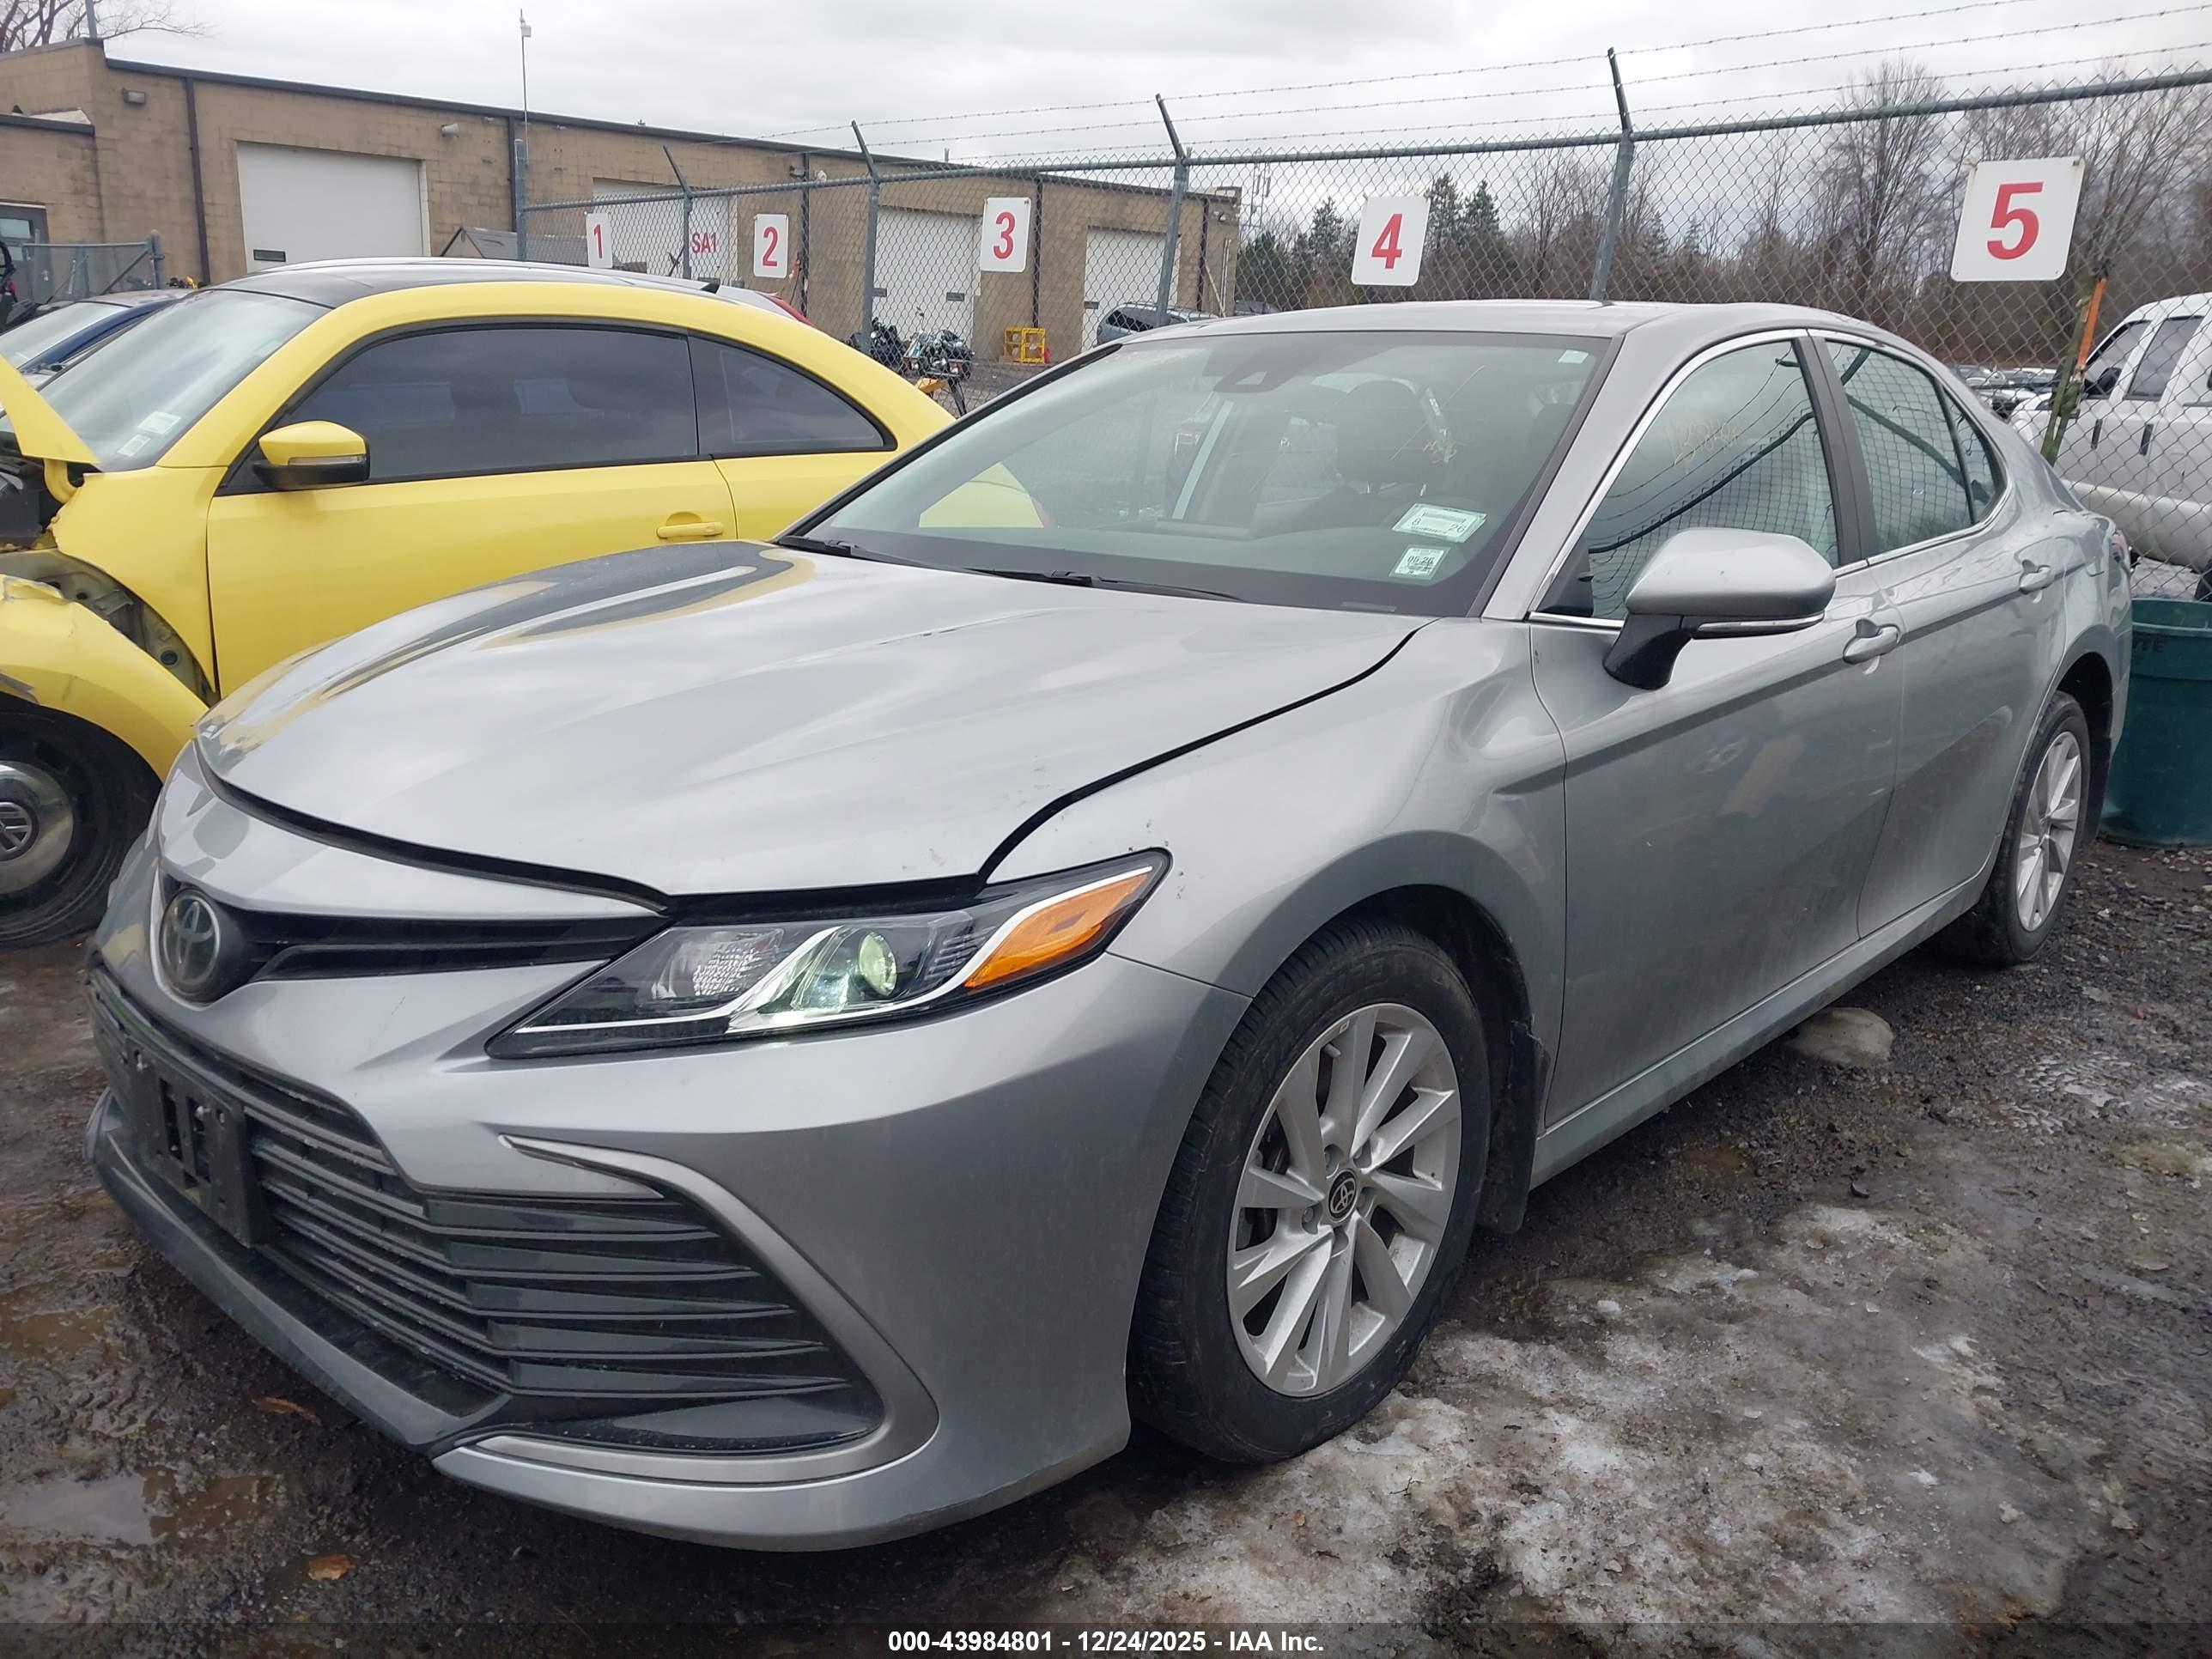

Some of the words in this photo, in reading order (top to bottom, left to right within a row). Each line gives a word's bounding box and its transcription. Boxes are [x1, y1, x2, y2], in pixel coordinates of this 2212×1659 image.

[593, 224, 603, 259] 1
[994, 212, 1017, 259] 3
[1370, 213, 1403, 270] 4
[1986, 181, 2045, 261] 5
[691, 232, 717, 254] SA1
[762, 227, 779, 267] 2
